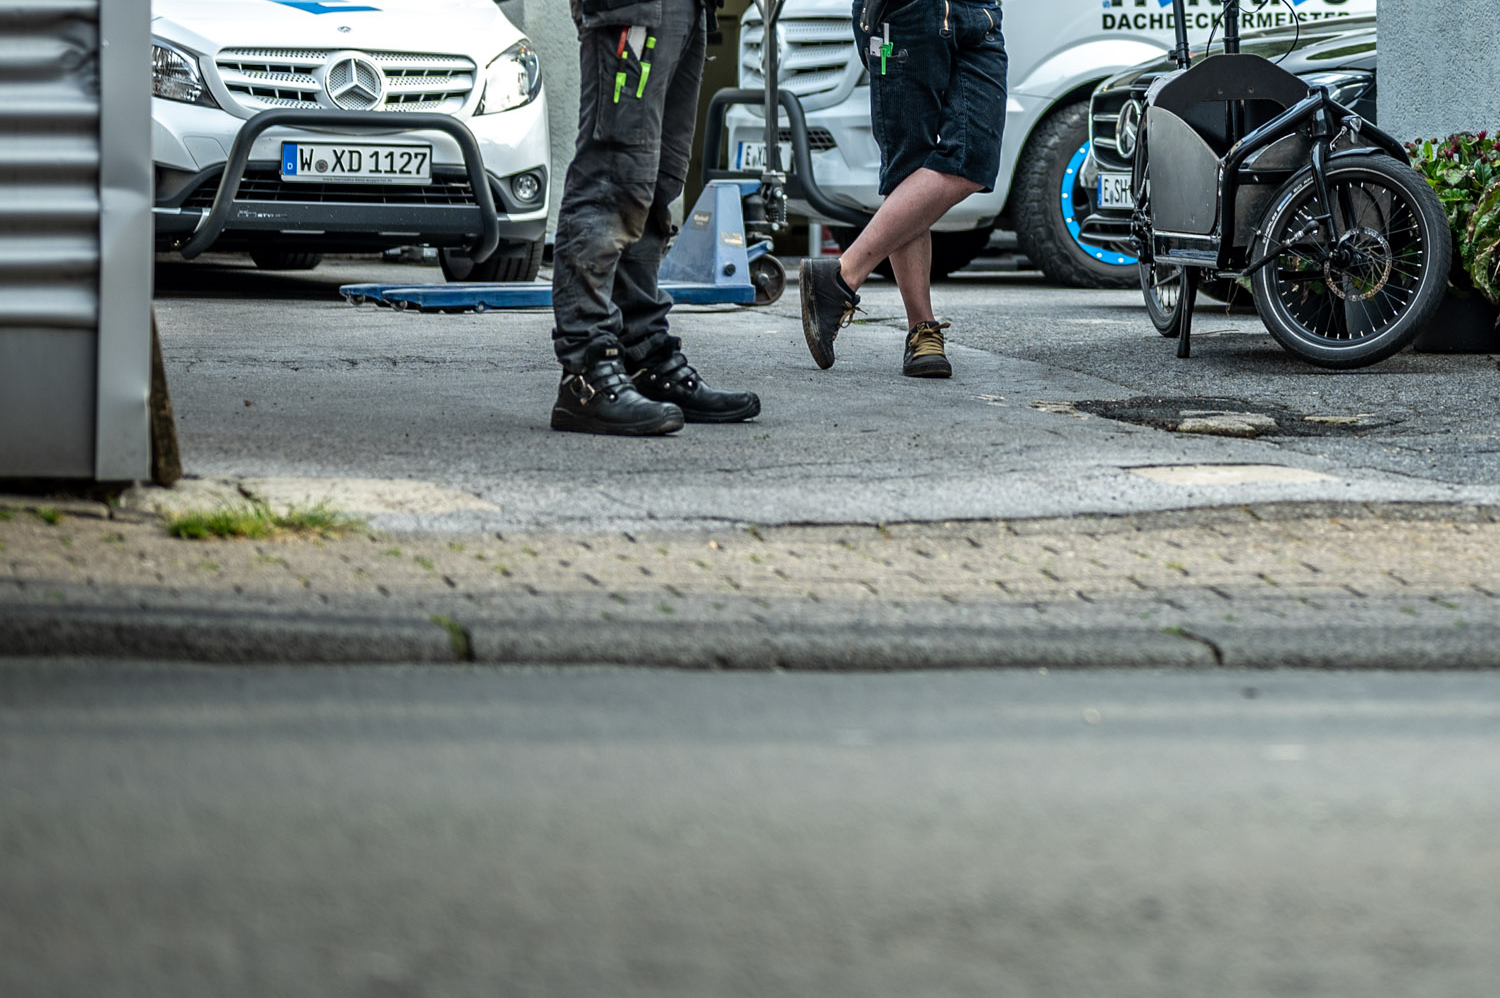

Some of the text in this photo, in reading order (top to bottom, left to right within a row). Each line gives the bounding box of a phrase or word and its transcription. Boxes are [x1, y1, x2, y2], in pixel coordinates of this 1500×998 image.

[300, 148, 314, 172] W
[331, 149, 362, 173] XD
[369, 151, 428, 175] 1127
[1104, 178, 1109, 203] E
